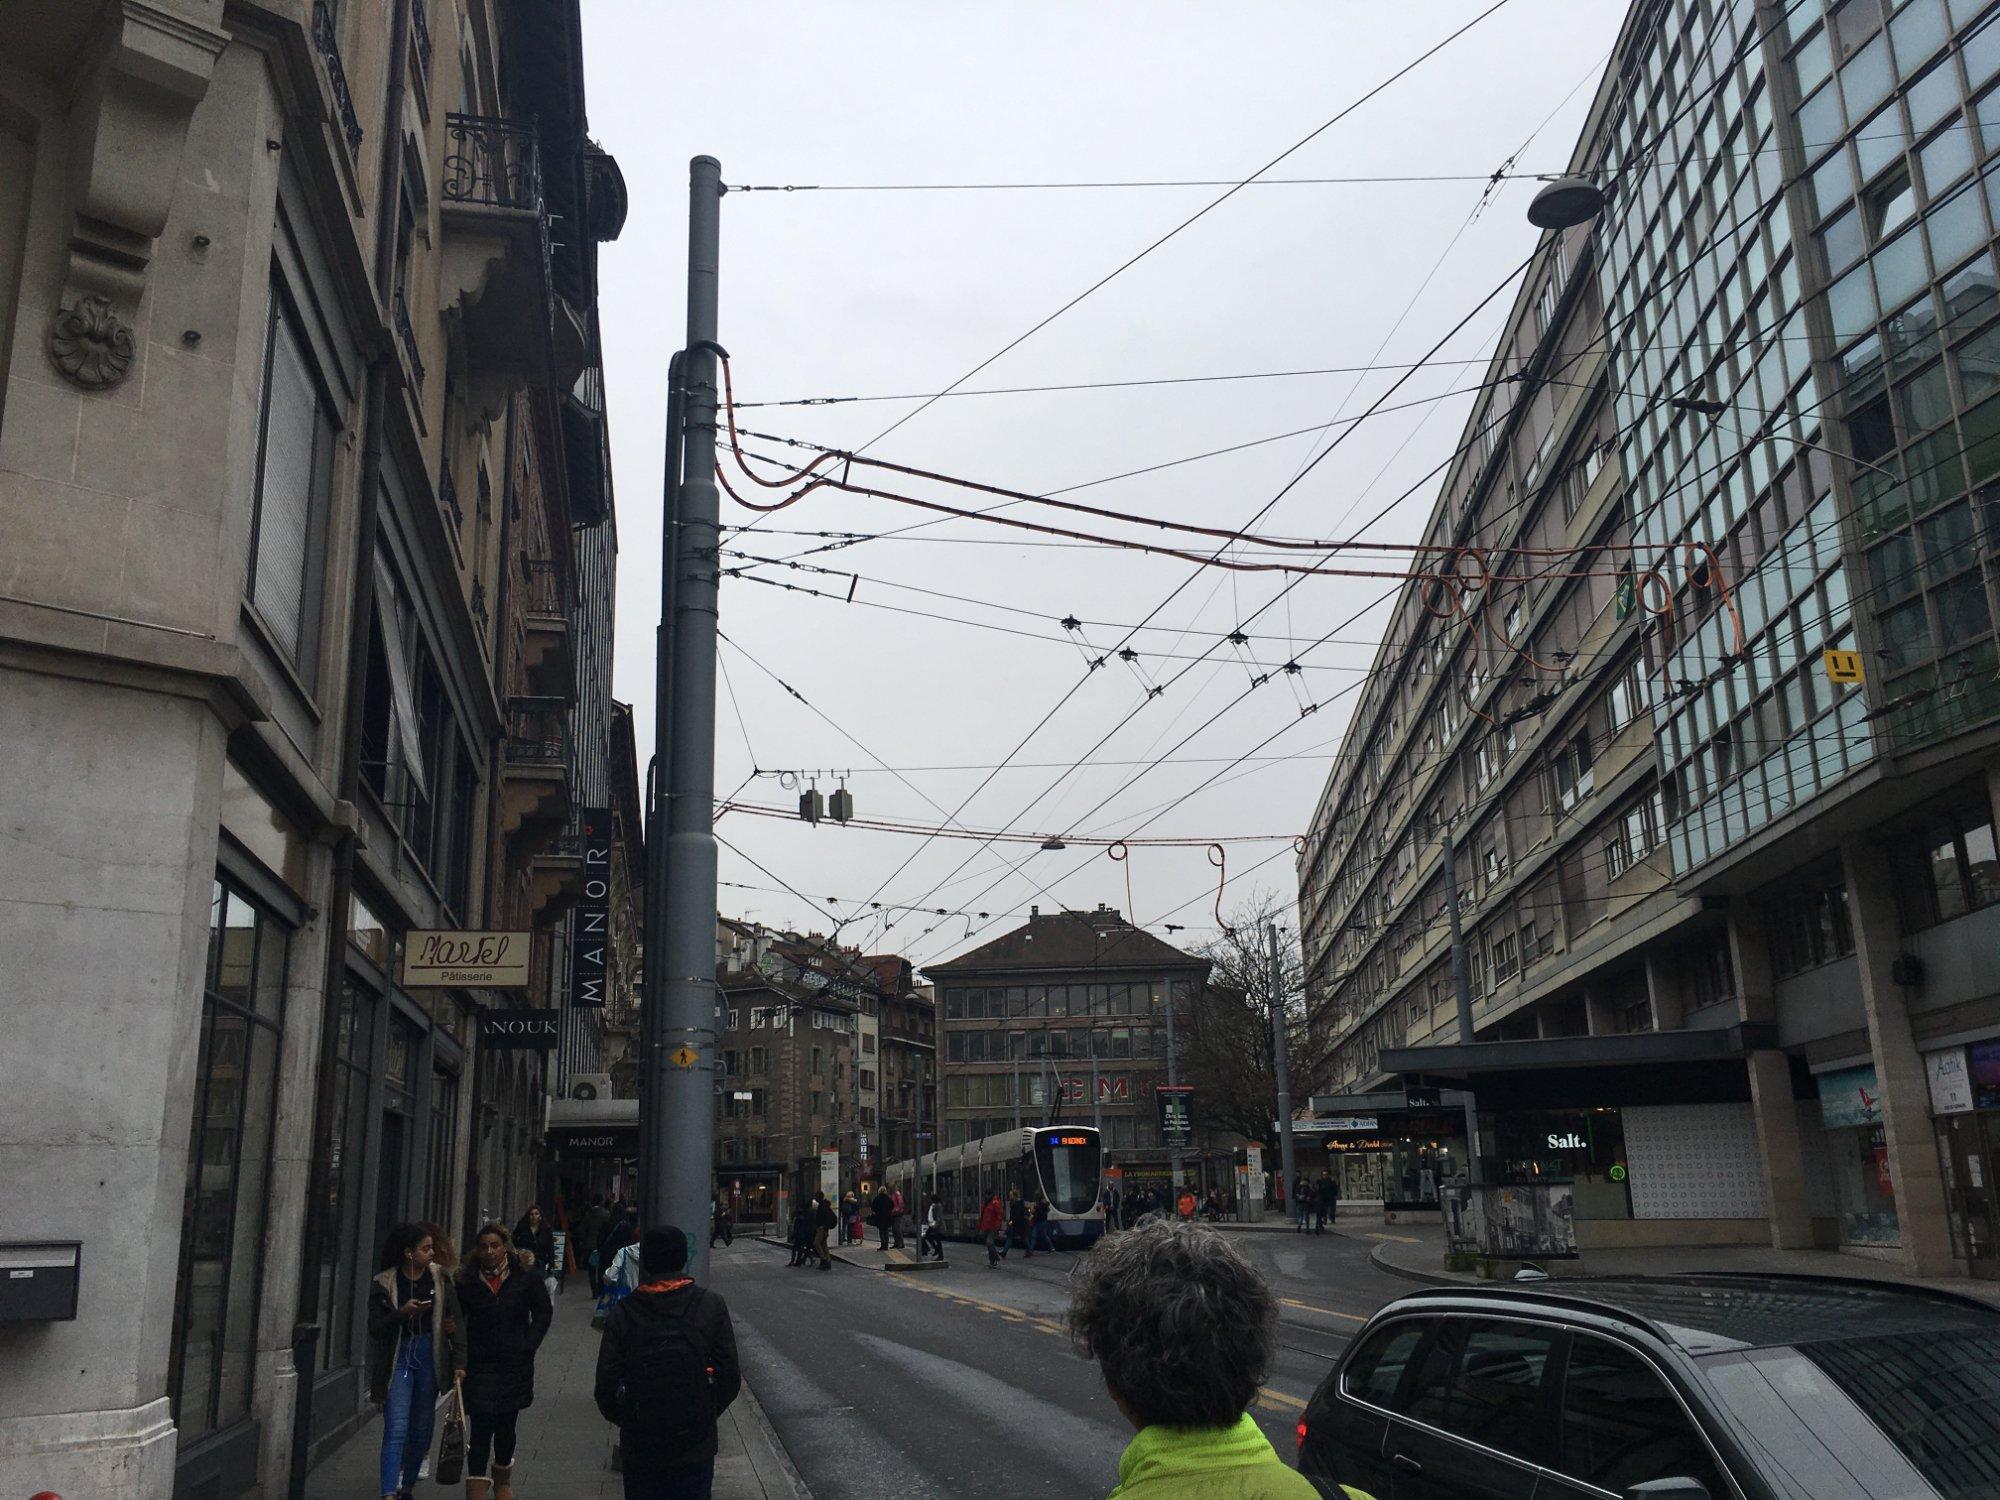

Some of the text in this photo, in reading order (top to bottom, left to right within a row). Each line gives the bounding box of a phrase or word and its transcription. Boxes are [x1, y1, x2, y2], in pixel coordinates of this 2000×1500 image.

[580, 847, 609, 1003] MANOR
[420, 935, 509, 965] Martel
[441, 970, 493, 981] Pâtisserie
[1408, 1098, 1430, 1107] Salt.
[568, 1136, 615, 1147] MANOR
[1547, 1132, 1588, 1150] Salt.
